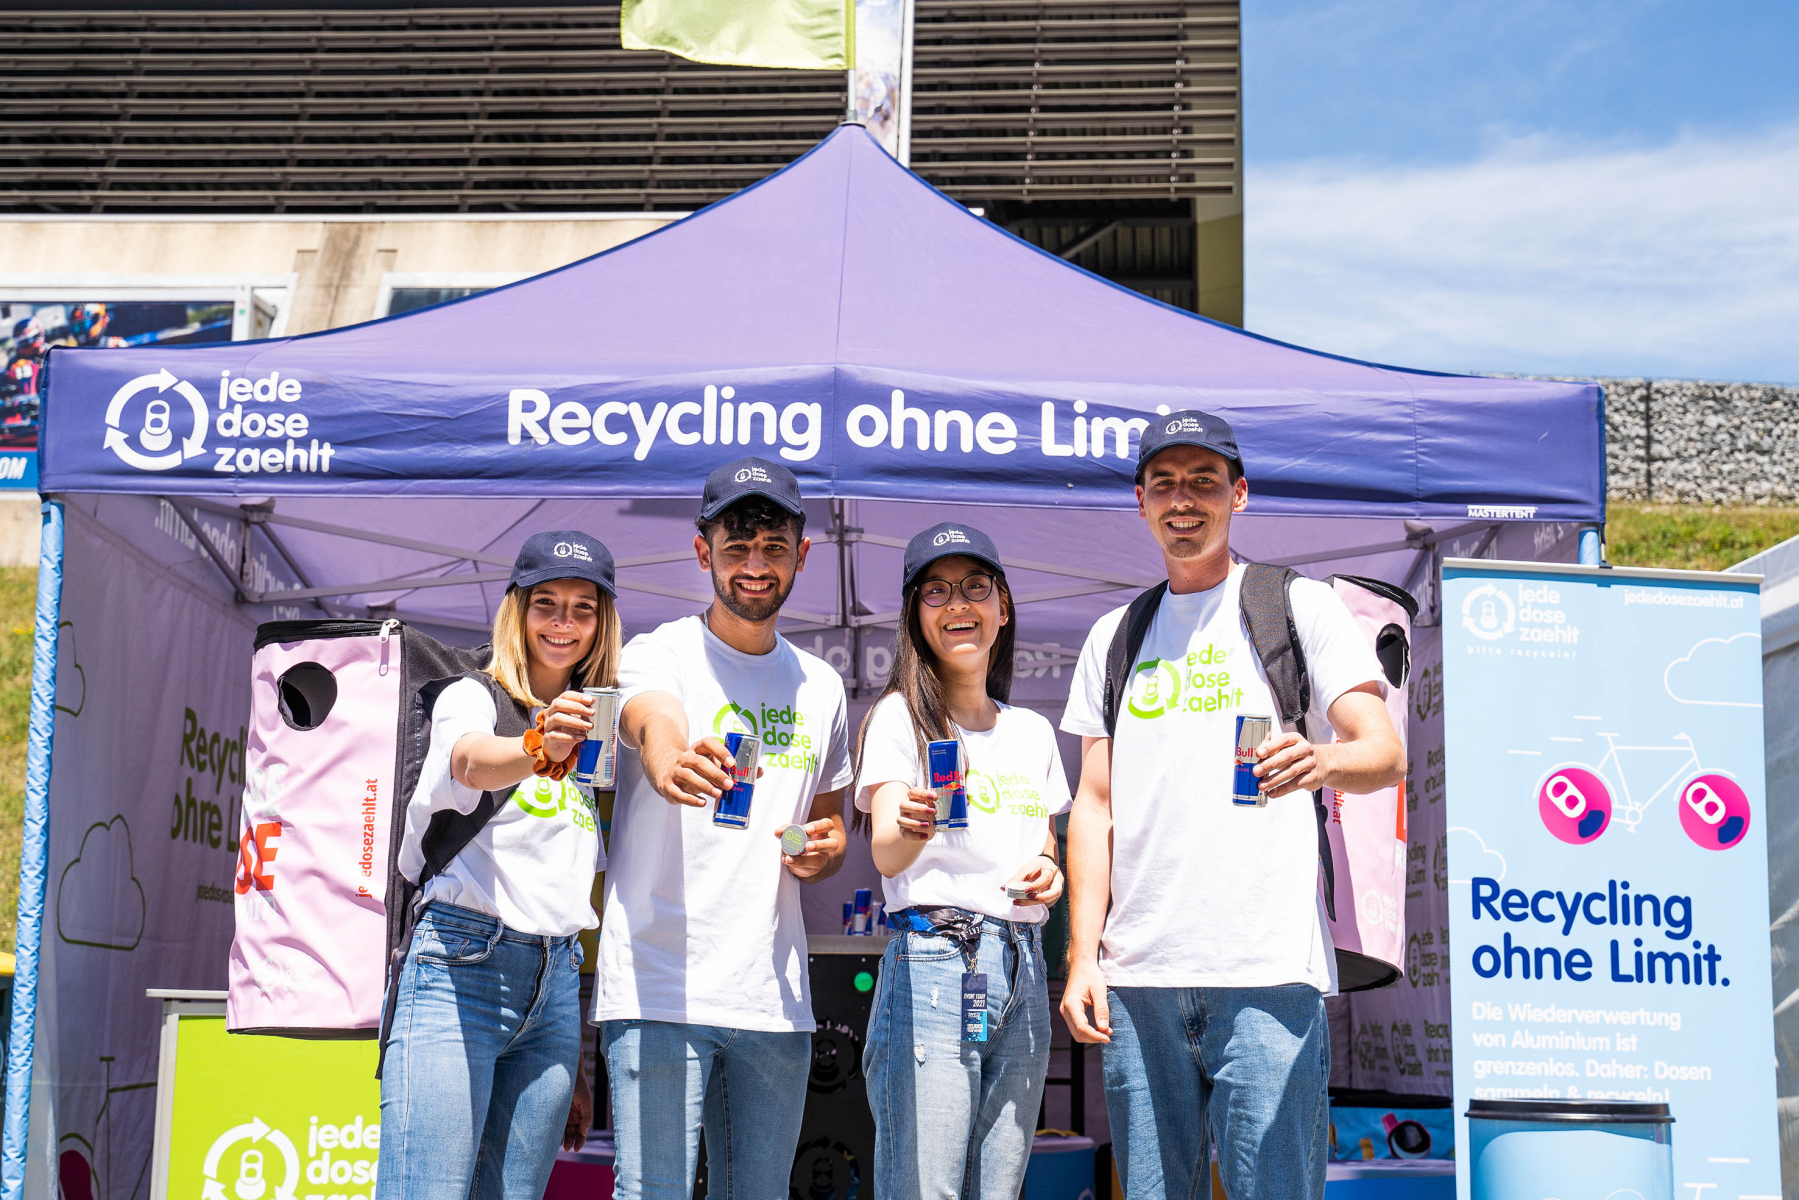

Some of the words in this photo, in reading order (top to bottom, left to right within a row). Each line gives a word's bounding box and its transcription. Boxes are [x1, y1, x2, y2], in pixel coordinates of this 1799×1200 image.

[219, 370, 302, 410] jede
[216, 403, 309, 438] dose
[507, 384, 822, 461] Recycling
[846, 389, 1018, 455] ohne
[1041, 400, 1180, 459] Lim
[213, 438, 335, 473] zaehlt
[1467, 506, 1537, 519] MASTERTENT
[1518, 583, 1561, 606] jede
[1624, 588, 1744, 609] jededosezaehlt.at
[1519, 605, 1567, 624] dose
[1519, 622, 1580, 645] zaehlt
[1187, 643, 1227, 666] ede
[761, 702, 804, 729] jede
[763, 725, 812, 750] dose
[1237, 747, 1254, 758] Bull
[933, 770, 953, 783] Red
[356, 778, 378, 899] jeedosezaehlt.at
[1472, 877, 1693, 940] Recycling
[1472, 932, 1593, 982] ohne
[1610, 938, 1730, 987] Limit.
[1472, 1002, 1503, 1021] Die
[1508, 1003, 1682, 1032] Wiederverwertung
[1472, 1031, 1506, 1048] von
[1511, 1029, 1611, 1051] Aluminium
[1616, 1032, 1639, 1052] ist
[1473, 1057, 1580, 1080] grenzenlos.
[1585, 1059, 1648, 1080] Daher:
[1654, 1060, 1712, 1081] Dosen
[308, 1115, 381, 1158] jede
